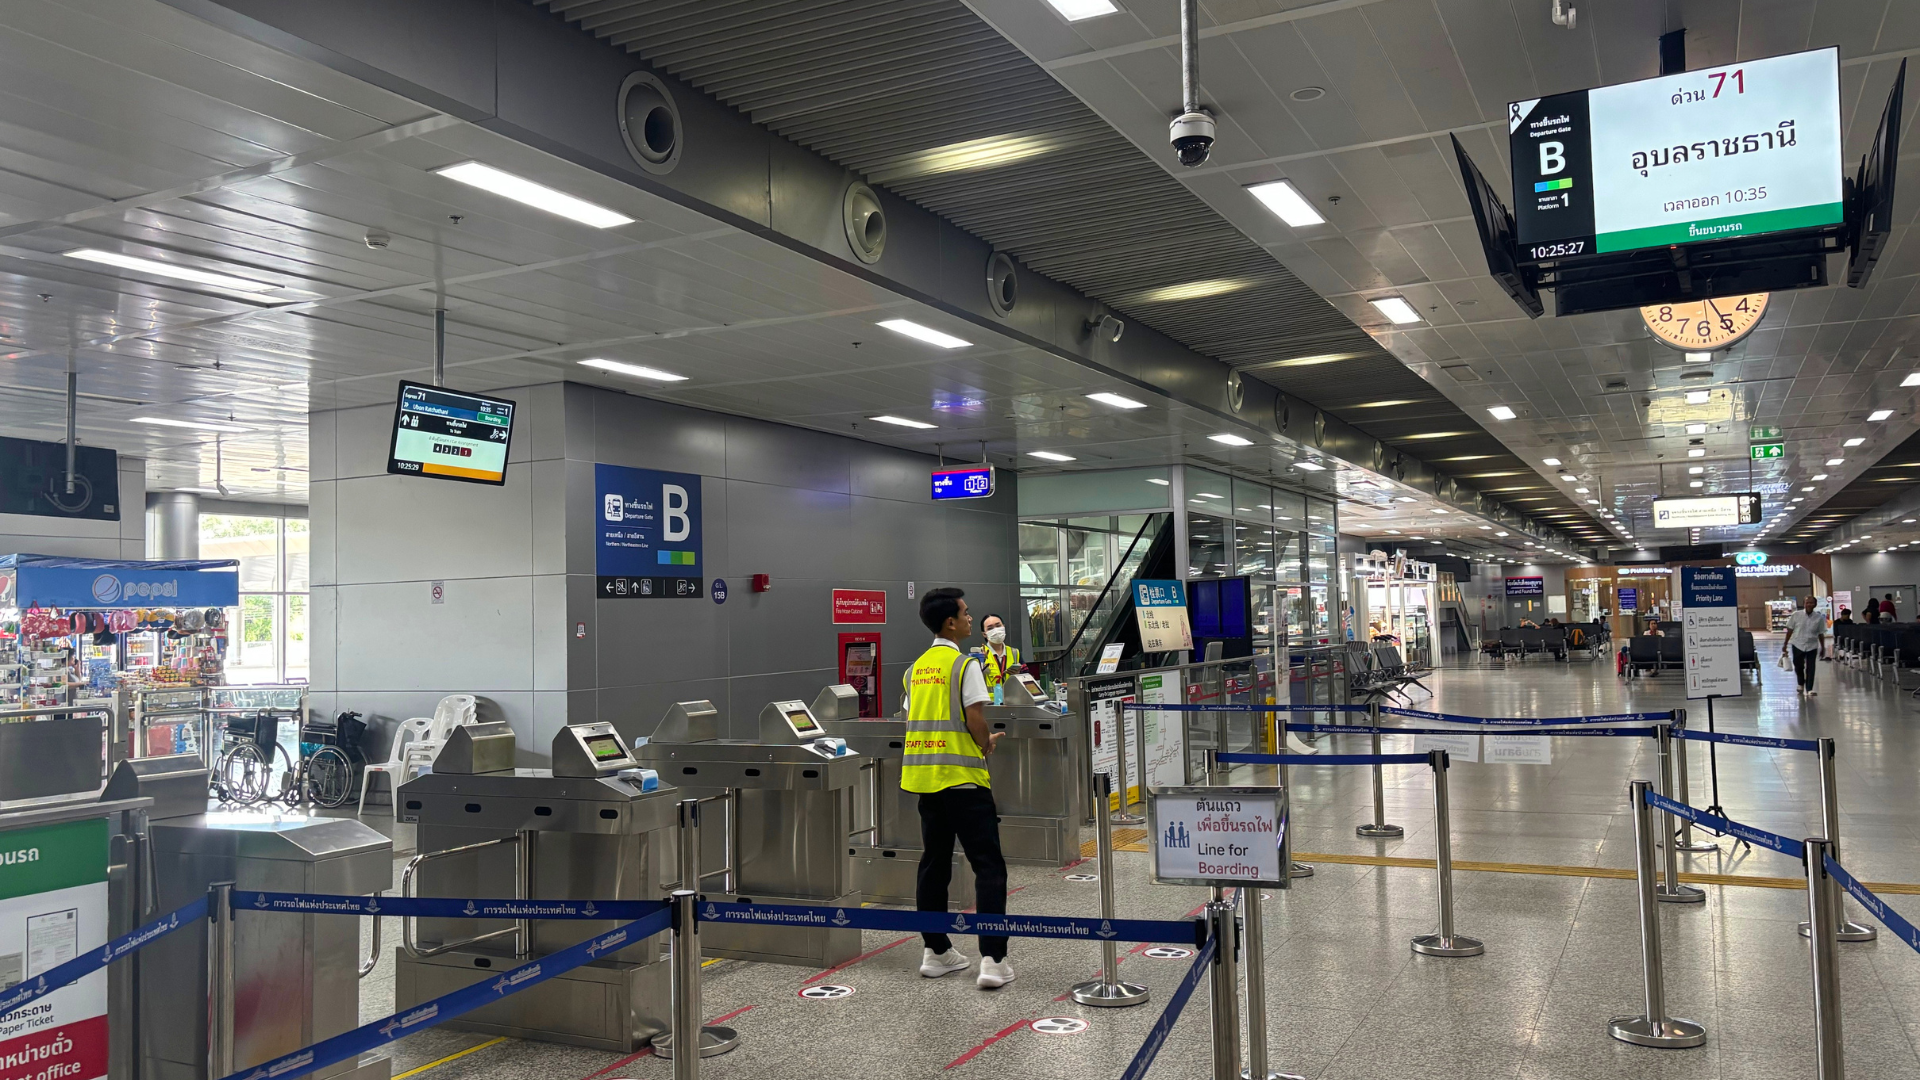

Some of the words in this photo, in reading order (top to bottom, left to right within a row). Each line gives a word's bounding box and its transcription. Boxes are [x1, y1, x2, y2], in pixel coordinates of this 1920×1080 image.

[1671, 87, 1706, 105] ด่วน
[1708, 68, 1745, 98] 71
[1530, 114, 1570, 129] ทางขึ้นรถไฟ
[1529, 129, 1557, 138] Departure
[1631, 119, 1797, 178] อุบลราชธานี
[1539, 141, 1566, 176] B
[1560, 192, 1569, 207] 1
[1663, 195, 1720, 212] เวลาออก
[1725, 186, 1767, 204] 10:35
[1537, 203, 1560, 211] Platform
[1688, 222, 1743, 237] ขึ้นขบวนรถ
[1530, 241, 1585, 259] 10:25:27
[1735, 297, 1750, 313] 4
[1659, 306, 1673, 322] 8
[1720, 313, 1734, 330] 5
[1676, 317, 1691, 334] 7
[1696, 320, 1711, 337] 6
[417, 392, 426, 401] 71
[480, 405, 492, 413] 10:35
[484, 415, 502, 423] Boarding
[397, 462, 420, 471] 10:25:29
[624, 499, 654, 510] ทางขึ้นรถไฟ
[624, 512, 644, 520] Departure
[663, 483, 691, 542] B
[1740, 554, 1763, 563] GPO
[123, 579, 178, 601] pepsi
[714, 591, 726, 600] 15B
[1171, 586, 1177, 599] B
[1695, 594, 1712, 603] Priority
[1712, 594, 1723, 602] Lane
[906, 740, 921, 748] STAFF
[924, 740, 946, 748] SERVICE
[1196, 797, 1241, 812] ต้นแถว
[1197, 814, 1272, 833] เพื่อขึ้นรถไฟ
[1198, 843, 1225, 856] Line
[1228, 844, 1248, 856] for
[1198, 861, 1259, 879] Boarding
[273, 897, 361, 911] การรถไฟแห่งประเทศไทย
[483, 903, 576, 916] การรถไฟแห่งประเทศไทย
[725, 907, 826, 923] การรถไฟแห่งประเทศไทย
[976, 917, 1089, 936] การรถไฟแห่งประเทศไทย
[26, 1014, 55, 1028] Ticket
